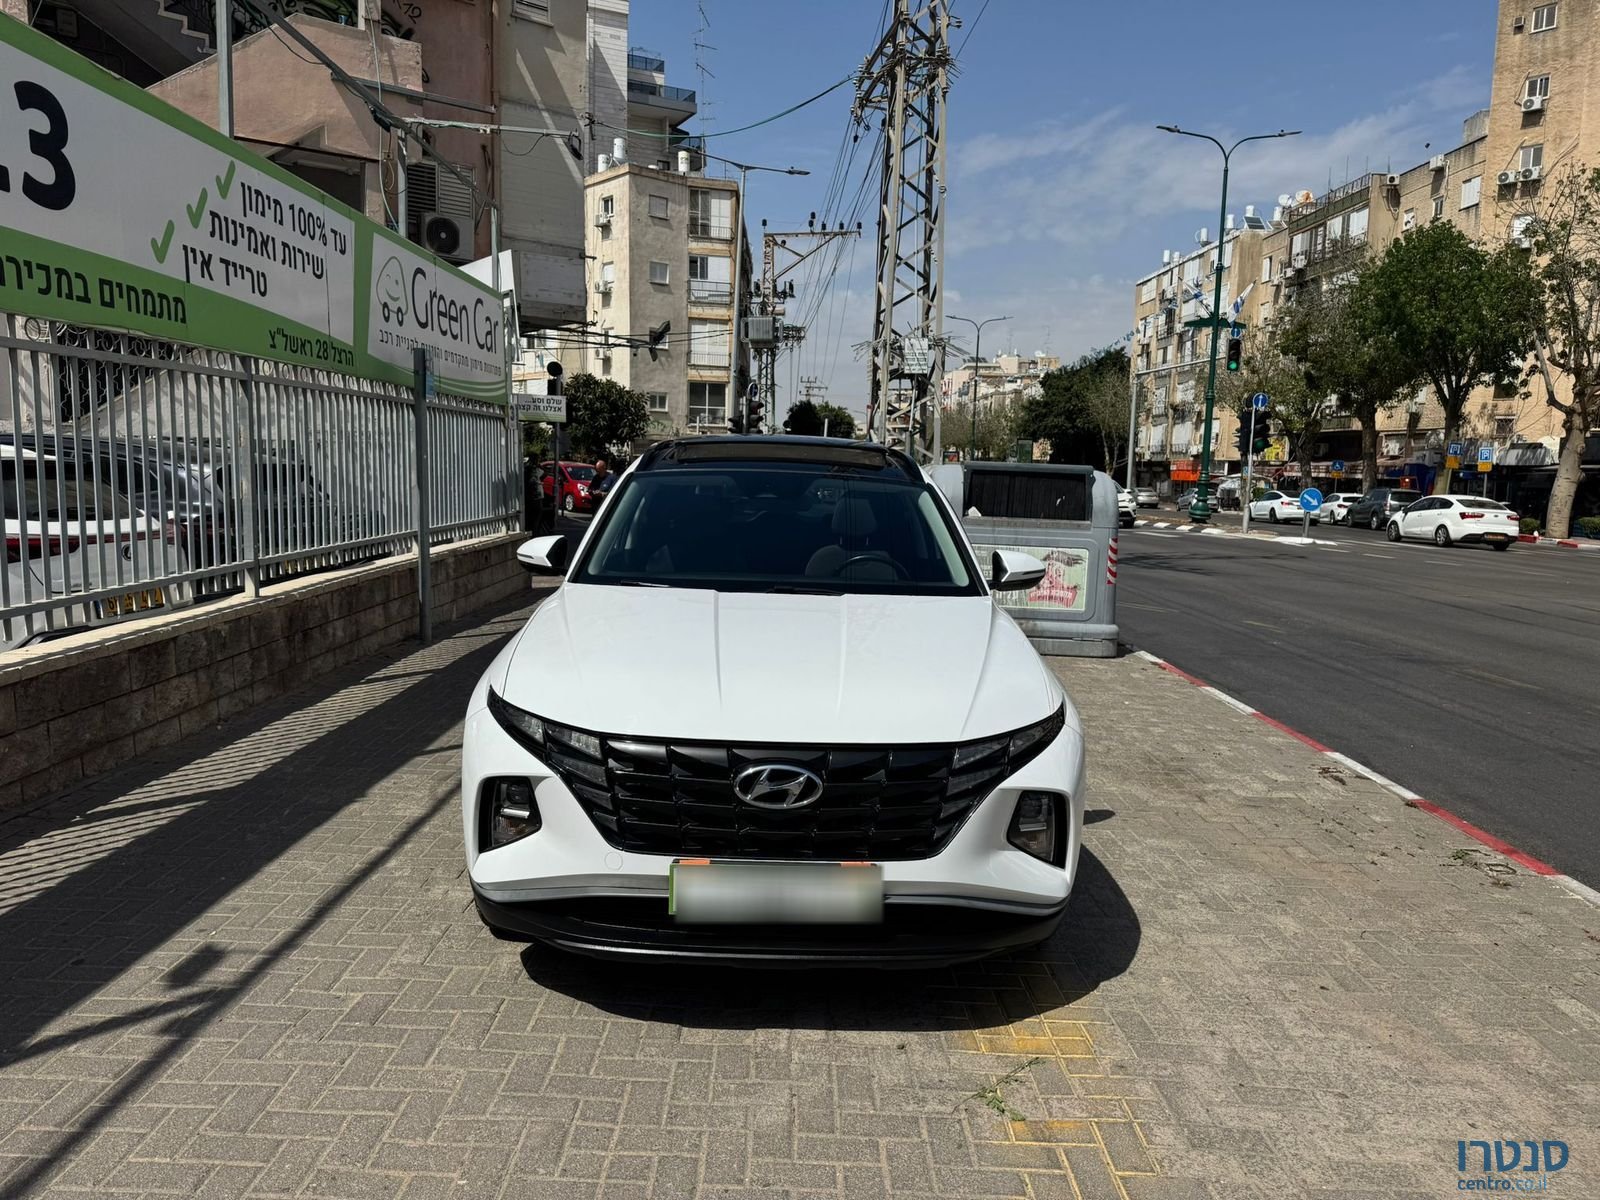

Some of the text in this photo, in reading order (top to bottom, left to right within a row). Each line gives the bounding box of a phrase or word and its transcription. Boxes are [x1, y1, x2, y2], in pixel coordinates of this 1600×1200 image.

[0, 80, 76, 211] 3
[240, 181, 347, 255] עד 100% מימון
[209, 209, 324, 280] שירות ואמינות
[182, 244, 268, 297] טרייד אין
[98, 277, 187, 324] מתמחים
[411, 266, 499, 355] Green Car
[315, 338, 329, 360] 28
[330, 341, 354, 367] הרצל
[378, 329, 394, 346] רכב
[546, 397, 562, 405] שלם
